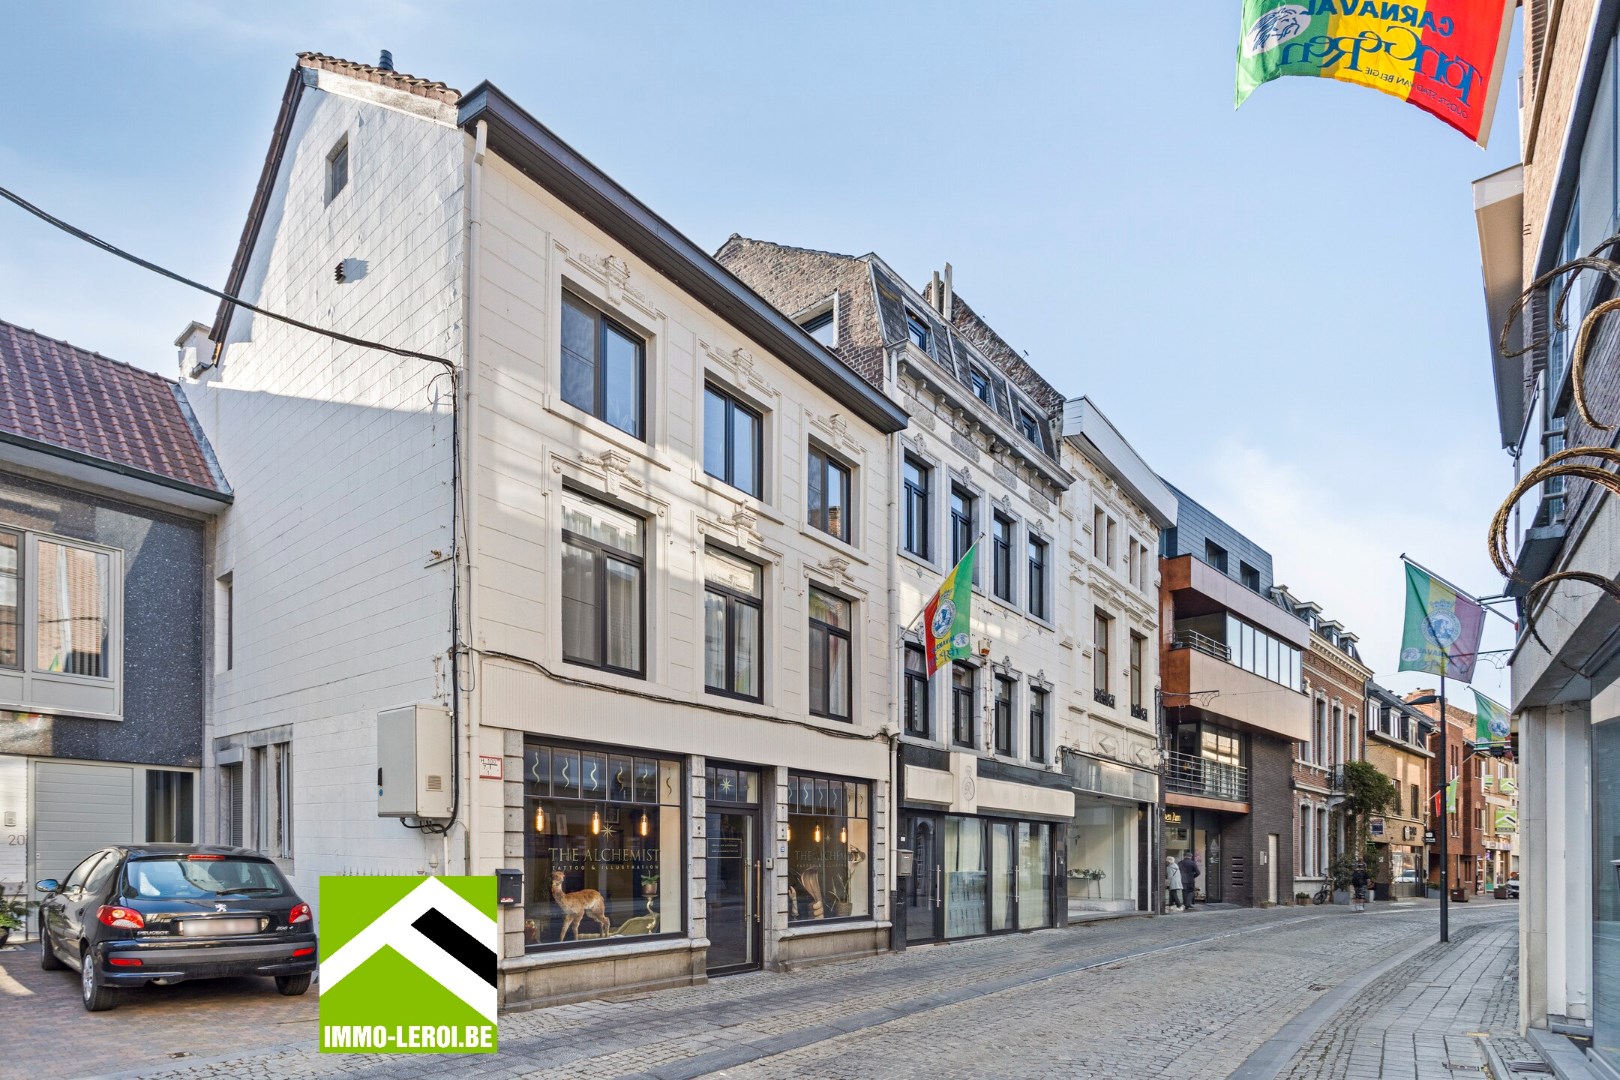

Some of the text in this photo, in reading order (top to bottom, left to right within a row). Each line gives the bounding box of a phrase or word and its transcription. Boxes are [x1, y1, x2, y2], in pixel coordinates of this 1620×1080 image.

[8, 834, 25, 846] 20
[548, 847, 661, 862] THE ALCHEMIST
